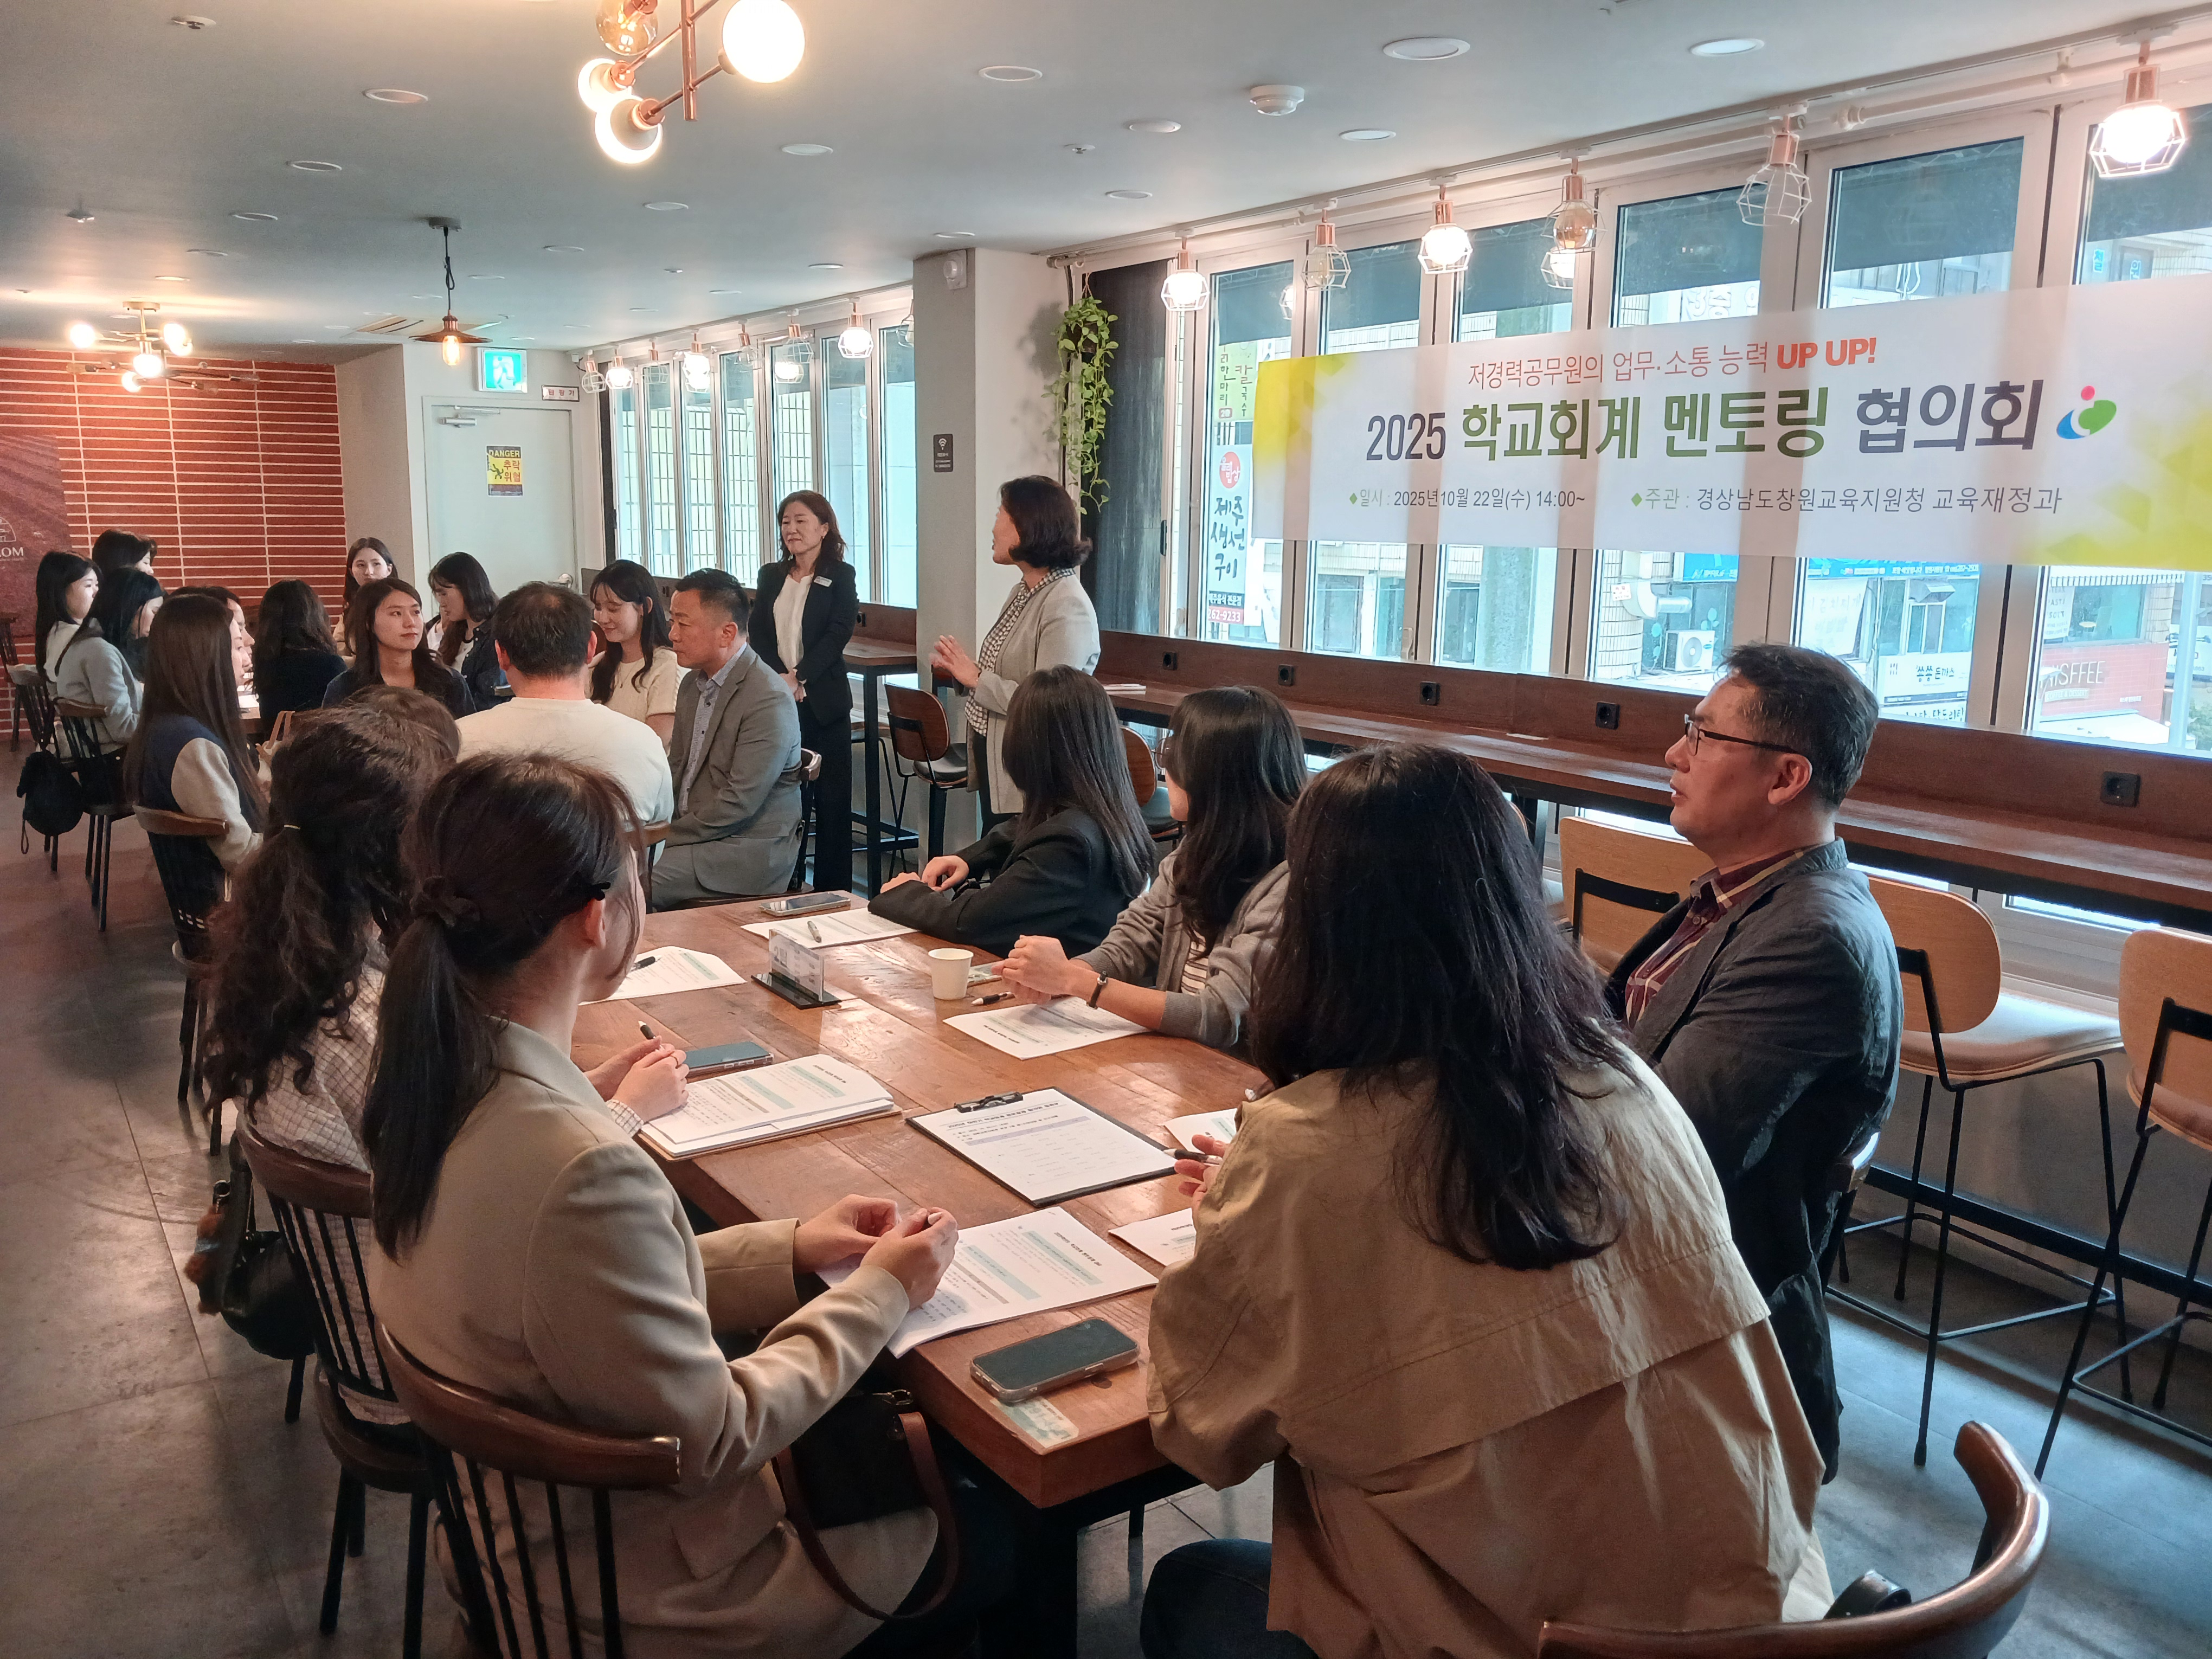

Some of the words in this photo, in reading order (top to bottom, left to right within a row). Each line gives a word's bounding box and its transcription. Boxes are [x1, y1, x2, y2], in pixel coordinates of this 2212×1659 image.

[1468, 353, 1603, 390] 저경력공무원의
[1719, 342, 1767, 375] 능력
[1777, 342, 1818, 369] UP
[1825, 337, 1876, 366] UP!
[1366, 412, 1446, 461] 2025
[1463, 396, 1641, 461] 학교회계
[1664, 387, 1828, 458] 멘토링
[1857, 380, 2044, 454] 협의회
[504, 460, 520, 470] 추락
[504, 472, 520, 482] 위험
[1214, 496, 1244, 526] 제주
[1360, 488, 1382, 507] 일시
[1473, 488, 1531, 511] 22일(수)
[1536, 490, 1585, 507] 14:00~
[1645, 488, 1680, 510] 주관
[1697, 488, 1925, 512] 경상남도창원교육지원청
[1933, 487, 2062, 514] 교육재정과
[1211, 522, 1245, 551] 생선
[1215, 553, 1237, 581] 구이
[1208, 608, 1241, 623] 262-9233
